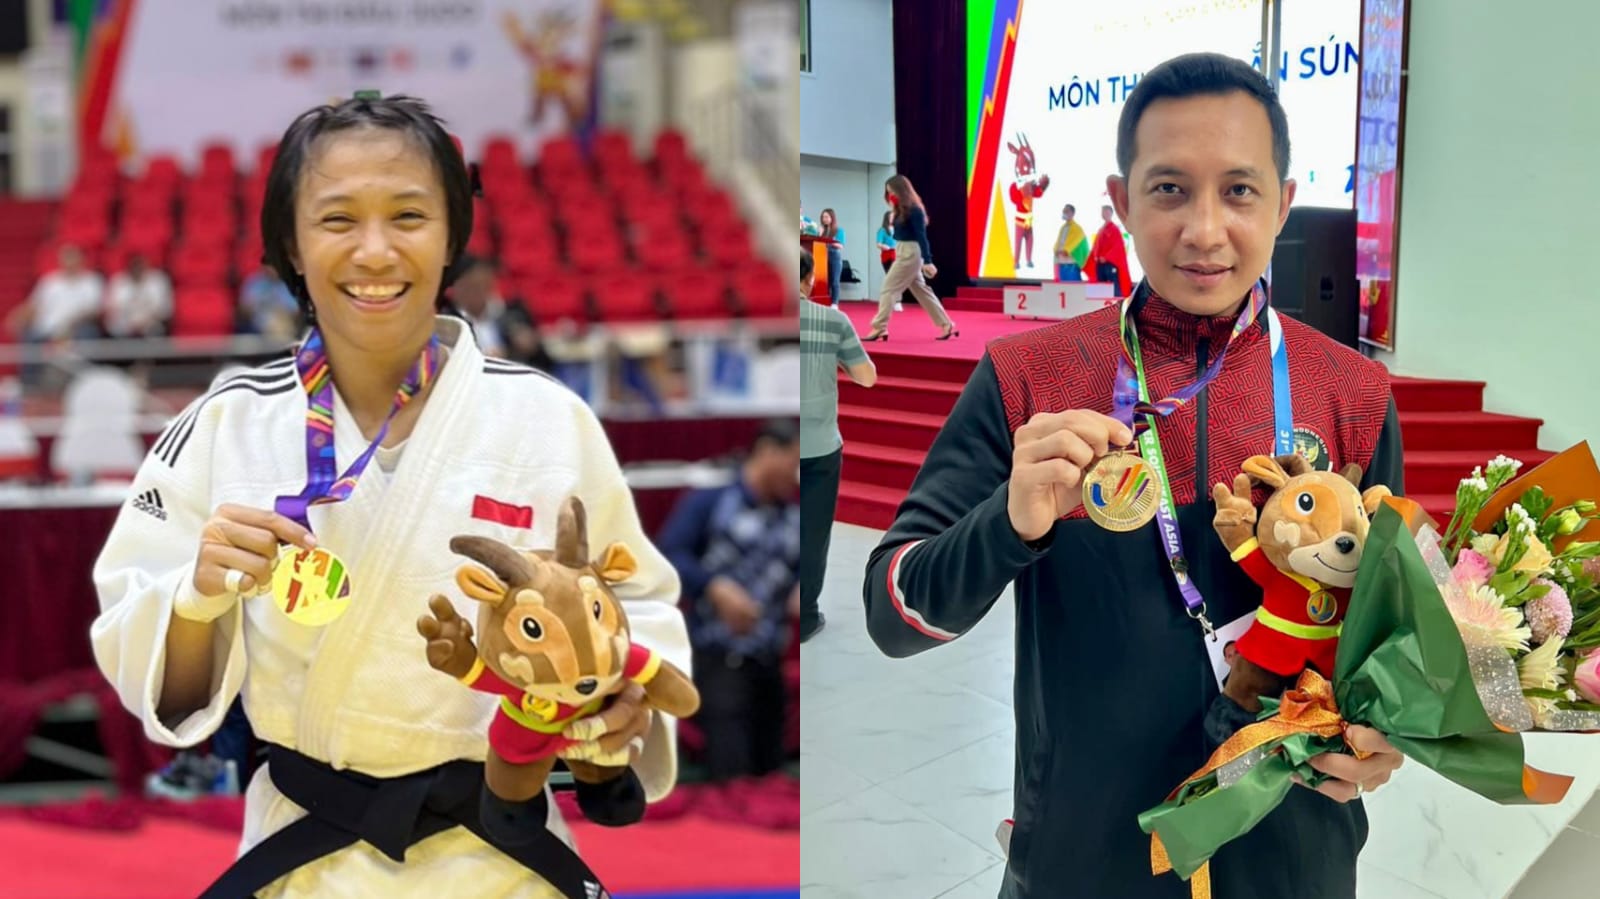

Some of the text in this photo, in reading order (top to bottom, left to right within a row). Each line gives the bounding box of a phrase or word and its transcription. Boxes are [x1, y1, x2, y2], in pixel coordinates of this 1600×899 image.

[1049, 75, 1100, 111] MÔN
[1107, 72, 1145, 103] TH
[1017, 292, 1027, 310] 2
[1059, 292, 1066, 309] 1
[1163, 522, 1180, 554] ASIA
